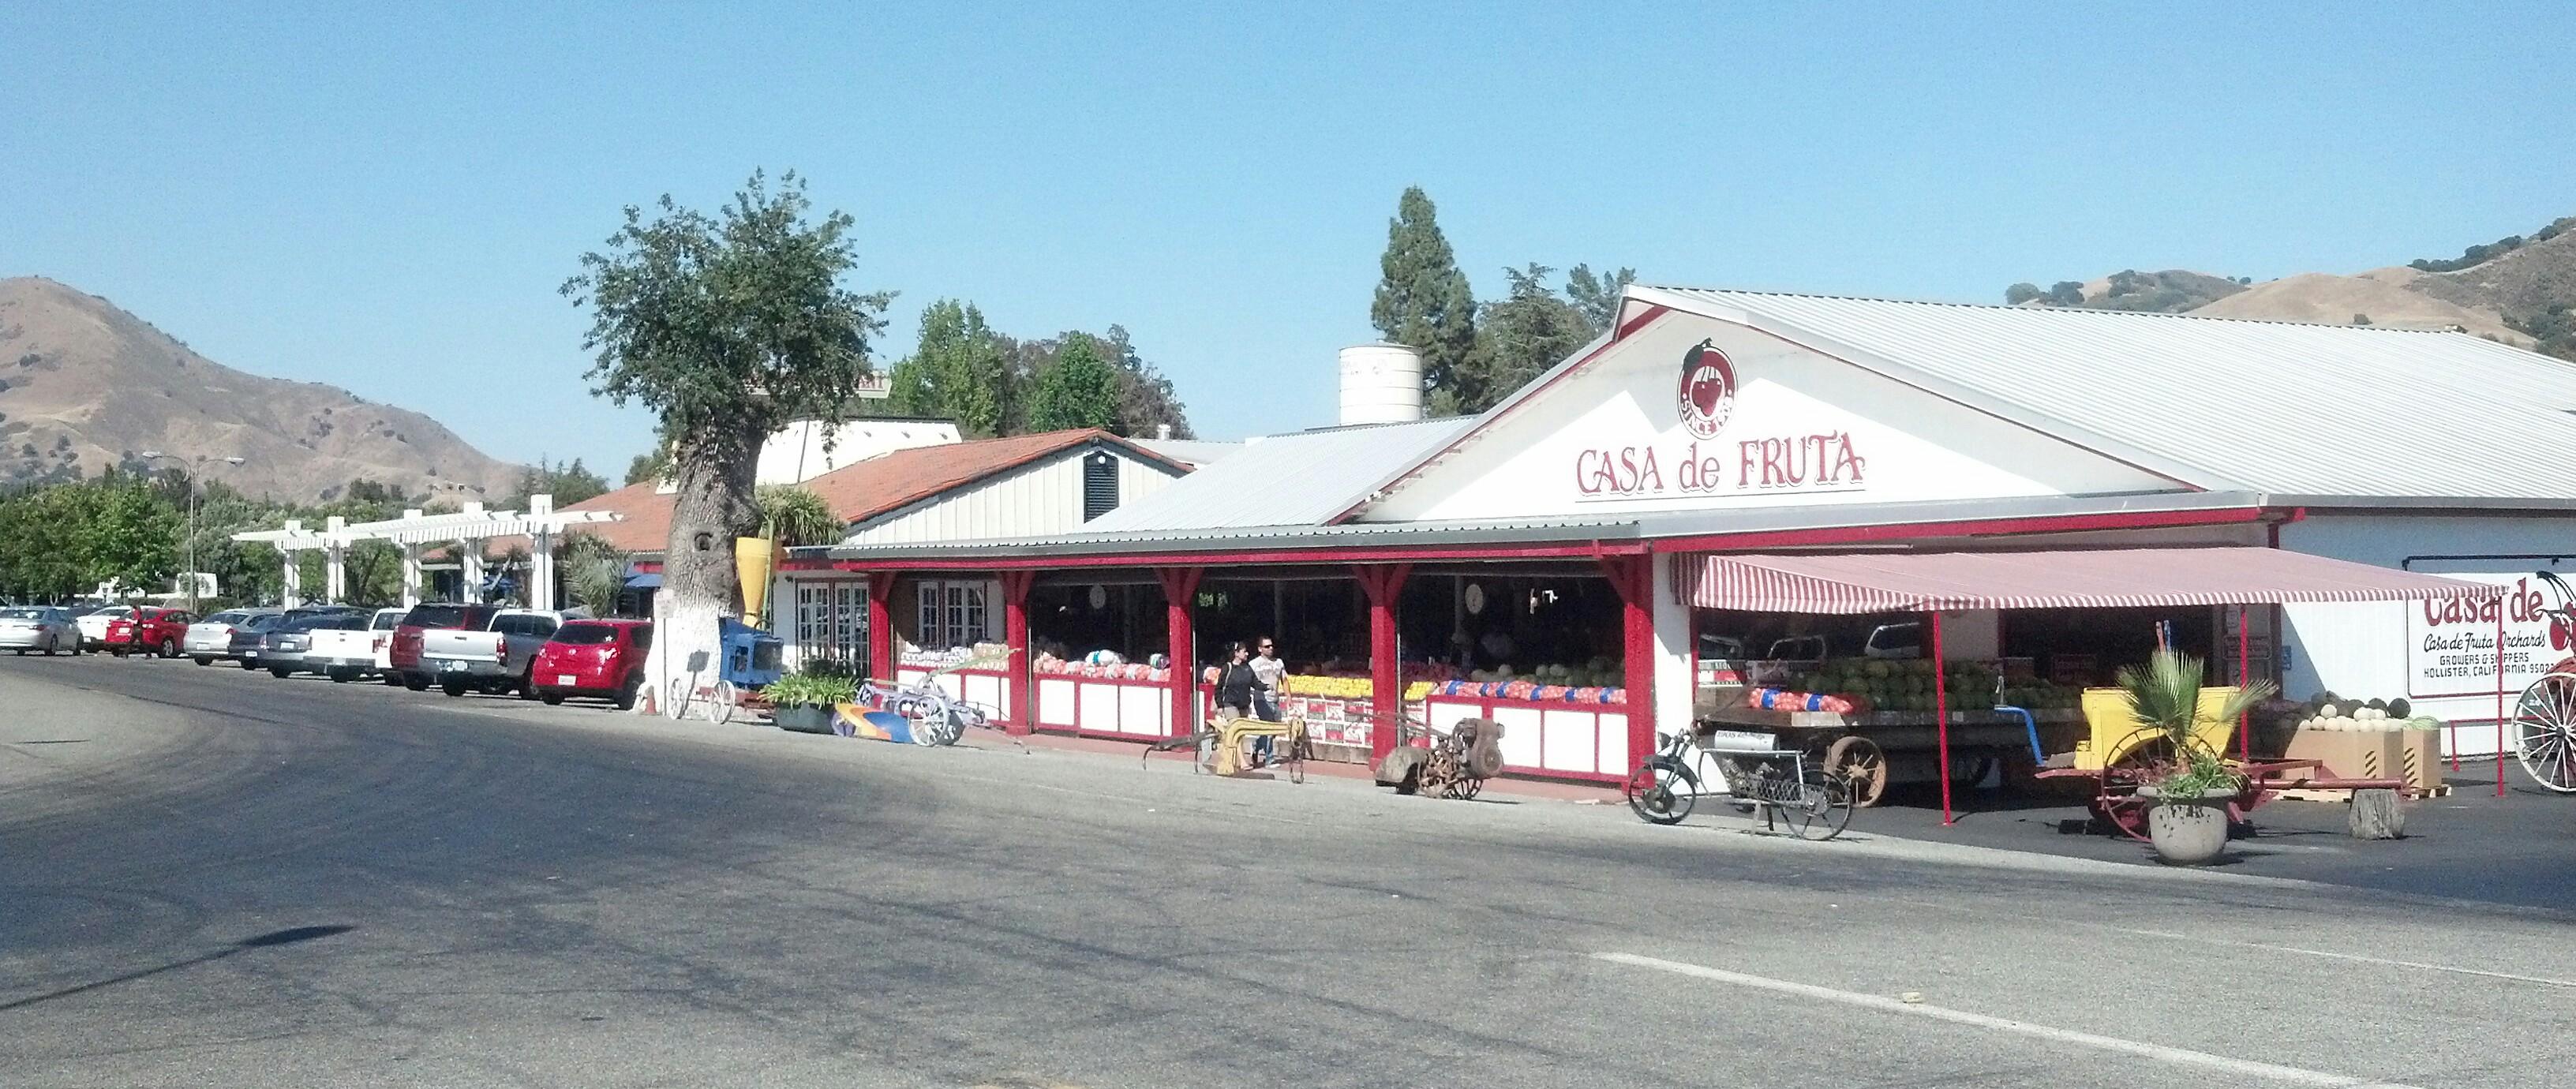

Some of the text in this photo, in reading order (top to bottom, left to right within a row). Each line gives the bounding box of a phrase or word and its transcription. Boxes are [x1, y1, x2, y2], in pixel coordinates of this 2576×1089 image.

[1681, 400, 1713, 435] SINCE
[1576, 429, 1866, 496] CASA de FRUTA
[2424, 577, 2544, 627] Casa de
[2424, 633, 2447, 653] Casa
[2449, 632, 2464, 650] de
[2465, 632, 2495, 653] Fruta
[2424, 663, 2555, 678] HOLLISTER, CALIFRNIA 9502
[2439, 654, 2480, 666] GROWERS
[2490, 652, 2529, 664] SHPPERS
